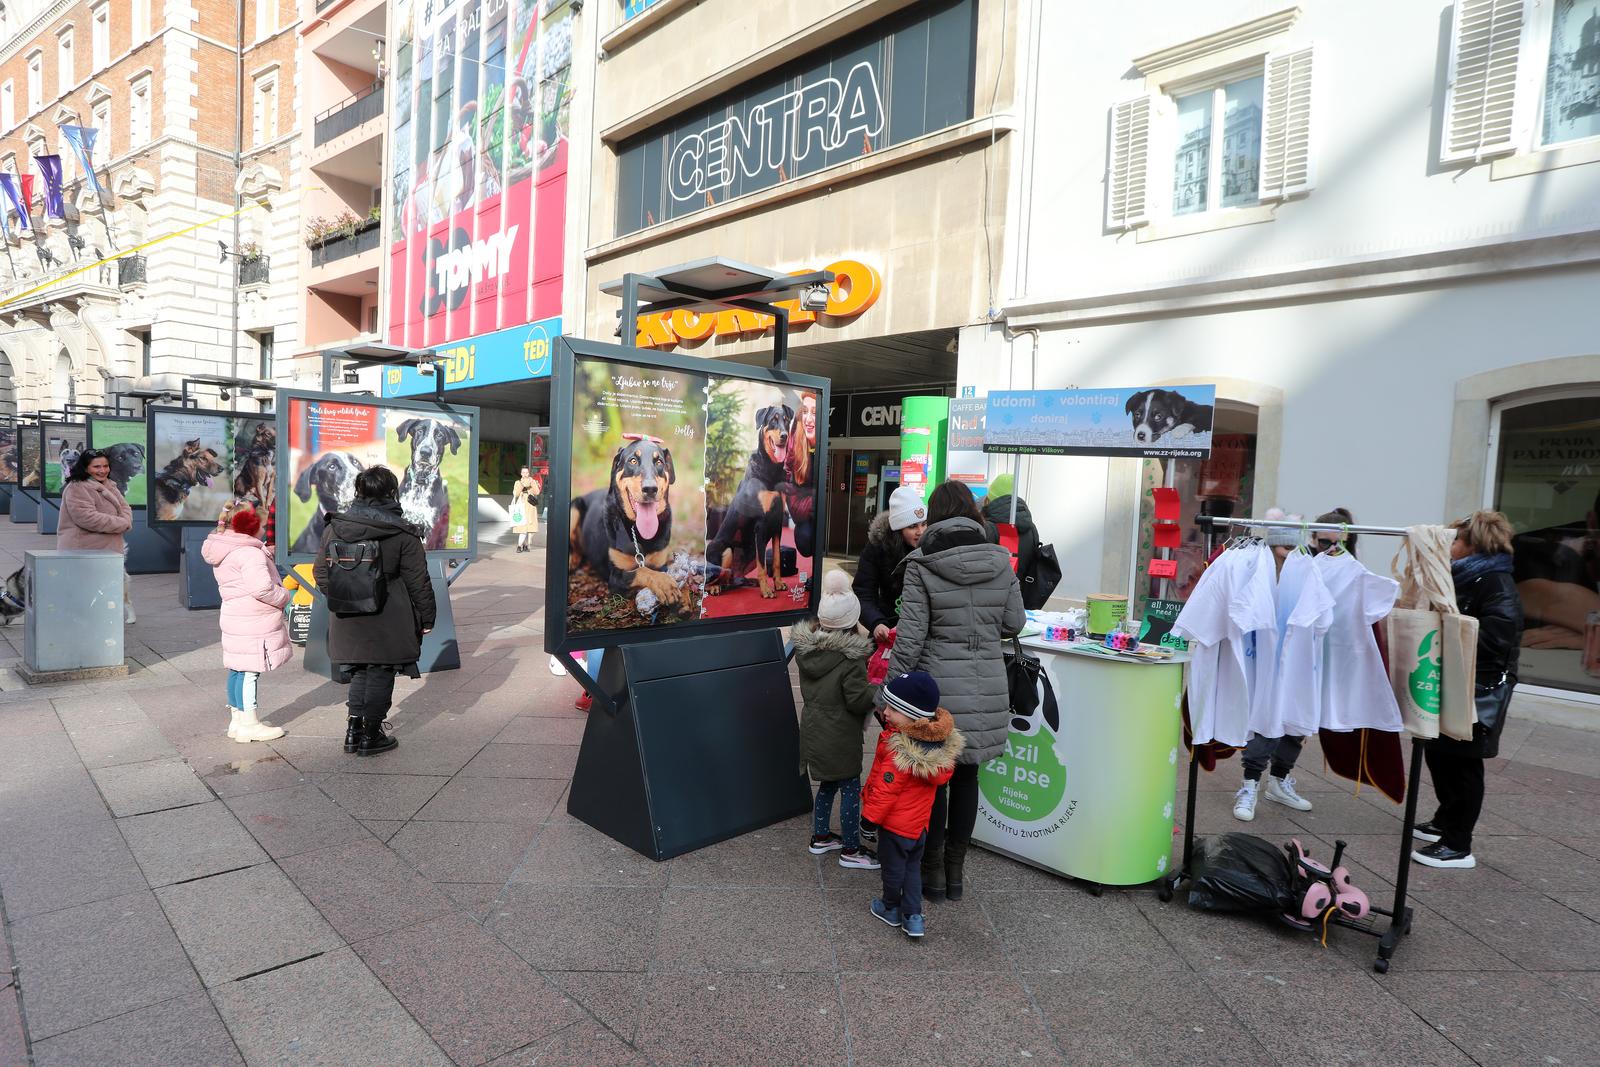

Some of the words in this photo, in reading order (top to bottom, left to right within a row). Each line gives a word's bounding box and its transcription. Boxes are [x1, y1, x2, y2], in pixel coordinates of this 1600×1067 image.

[668, 61, 885, 201] CENTRA
[435, 224, 519, 296] TOMMY
[523, 338, 549, 362] TEDi
[387, 368, 402, 385] TEDi
[963, 386, 973, 396] 12
[952, 403, 973, 412] CAFFE
[992, 395, 1036, 408] udomi
[1060, 394, 1120, 408] volontiraj
[861, 405, 902, 426] CENT
[1030, 413, 1069, 425] doniraj
[674, 424, 695, 440] Dolly
[1143, 449, 1202, 458] www.zz-rijeka.org
[1166, 603, 1181, 612] you
[1004, 739, 1039, 764] Azil
[1014, 766, 1050, 788] pse
[1002, 786, 1029, 801] Rijeka
[998, 795, 1031, 813] Viškovo
[987, 814, 1019, 836] ZAŠTITU
[1021, 822, 1061, 838] ŽIVOTINJA
[1058, 799, 1078, 825] RIJEKA
